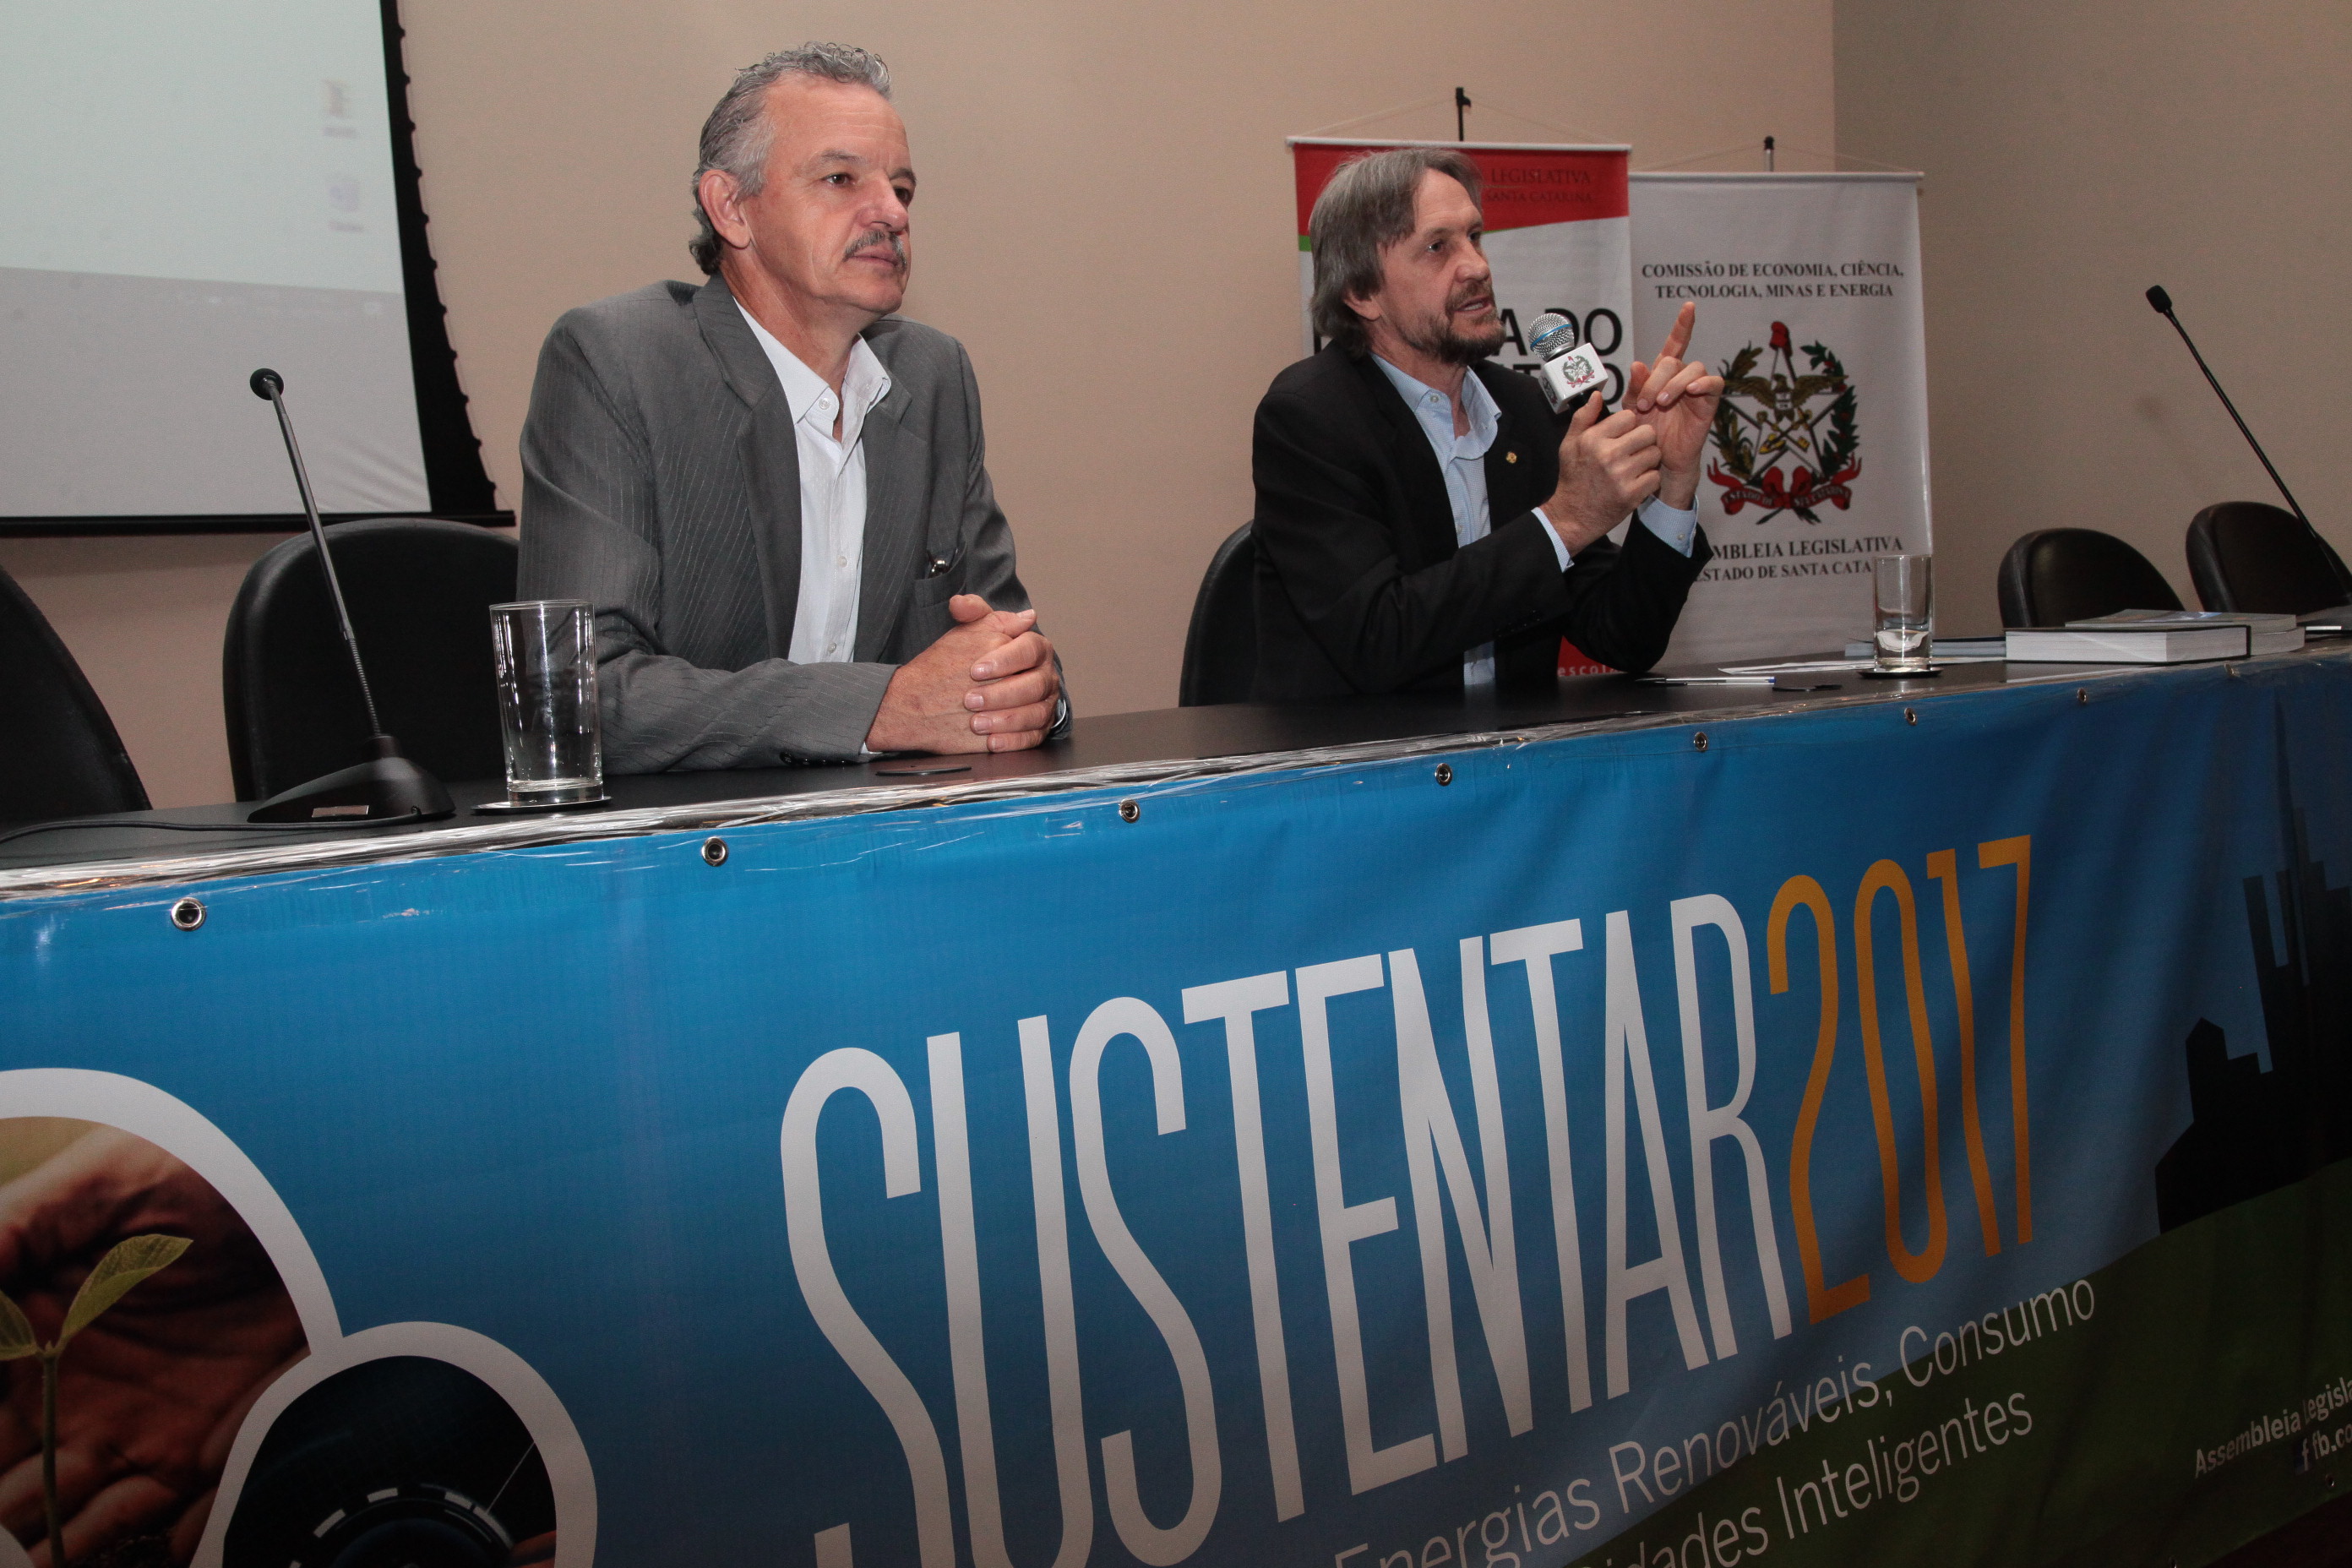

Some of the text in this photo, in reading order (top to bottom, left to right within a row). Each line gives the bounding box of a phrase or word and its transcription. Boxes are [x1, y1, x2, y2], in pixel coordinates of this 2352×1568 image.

[1491, 168, 1591, 184] LEGISLATIVA
[1488, 191, 1592, 204] SANTA CATARINA
[1642, 260, 1904, 278] COMISSÃO DE ECONOMIA, CIÊNCIA,
[1655, 283, 1893, 299] TECNOLOGIA, MINAS E ENERGIA
[1712, 536, 1903, 561] MBLEIA LEGISLATIVA
[1758, 564, 1778, 579] DE
[1781, 561, 1829, 578] SANTA
[1832, 559, 1872, 575] CATA
[1609, 1355, 1893, 1515] Renováveis,
[1899, 1278, 2095, 1389] Consumo
[2194, 1376, 2352, 1479] Assembleia Legisla
[2312, 1423, 2352, 1460] fb.co
[1777, 1391, 2034, 1541] Inteligentes
